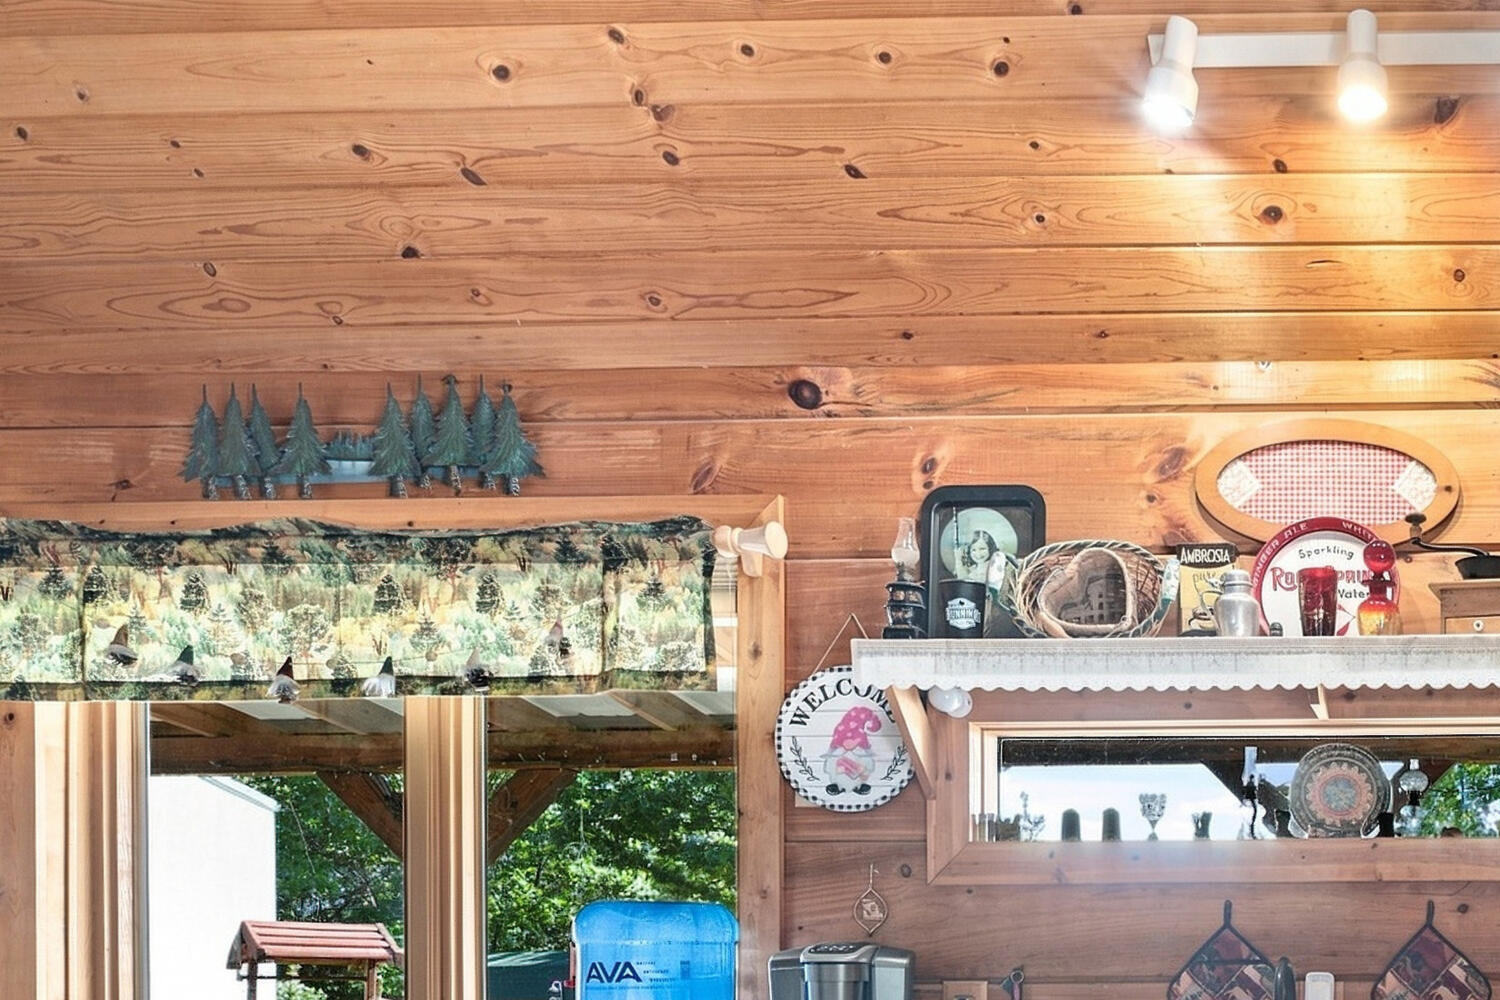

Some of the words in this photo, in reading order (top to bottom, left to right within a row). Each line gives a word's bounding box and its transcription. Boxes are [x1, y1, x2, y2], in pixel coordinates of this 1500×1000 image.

[1283, 521, 1309, 540] ALE
[1180, 547, 1231, 564] AMBROSIA
[1298, 545, 1355, 560] Sparkling
[585, 961, 643, 984] AVA
